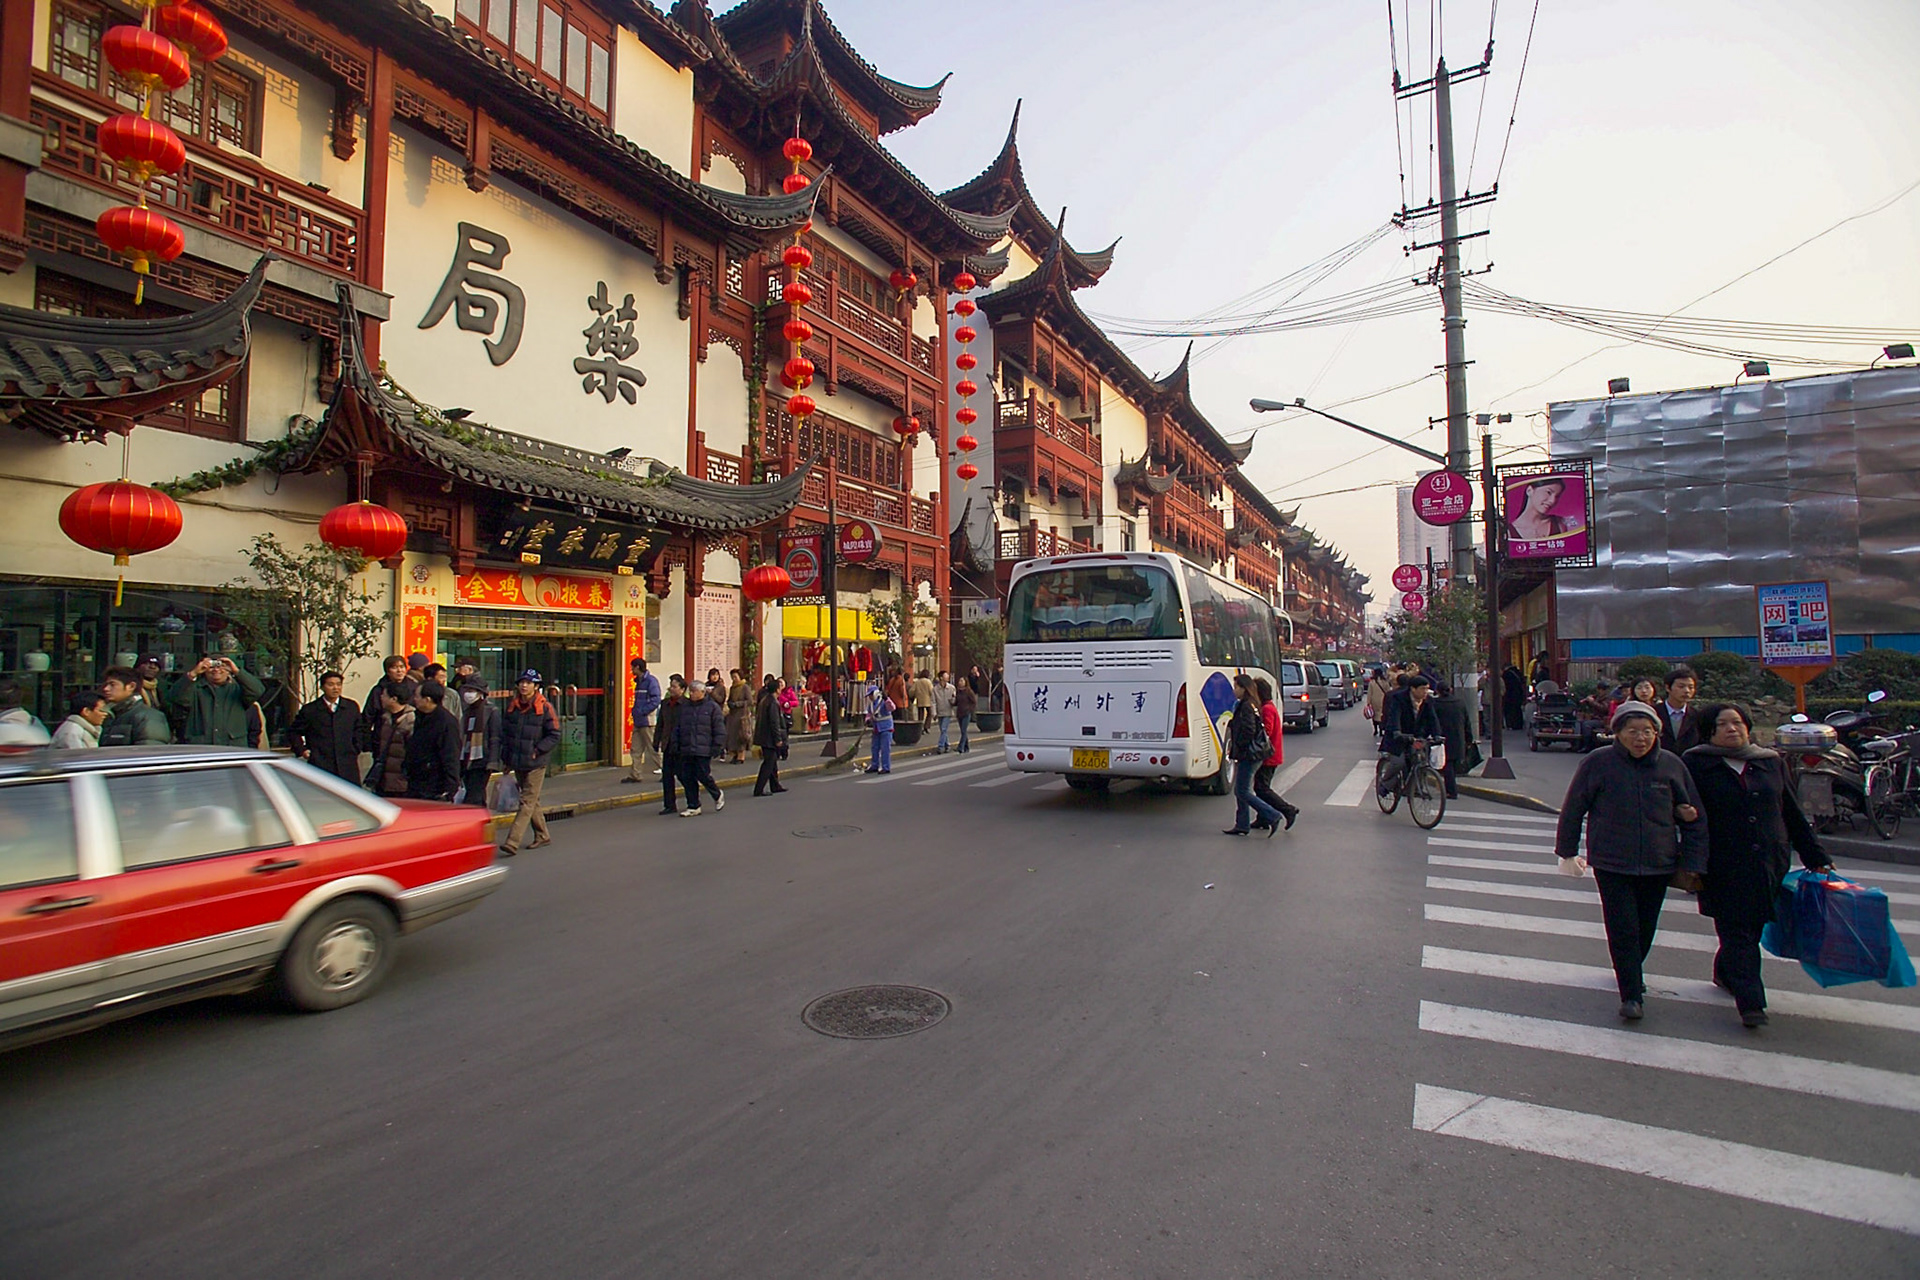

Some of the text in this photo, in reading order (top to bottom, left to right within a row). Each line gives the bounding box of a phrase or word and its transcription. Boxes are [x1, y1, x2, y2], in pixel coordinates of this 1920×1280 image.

[1421, 495, 1464, 507] 亚一金店
[1073, 757, 1108, 769] 46406
[1114, 752, 1141, 763] ABS
